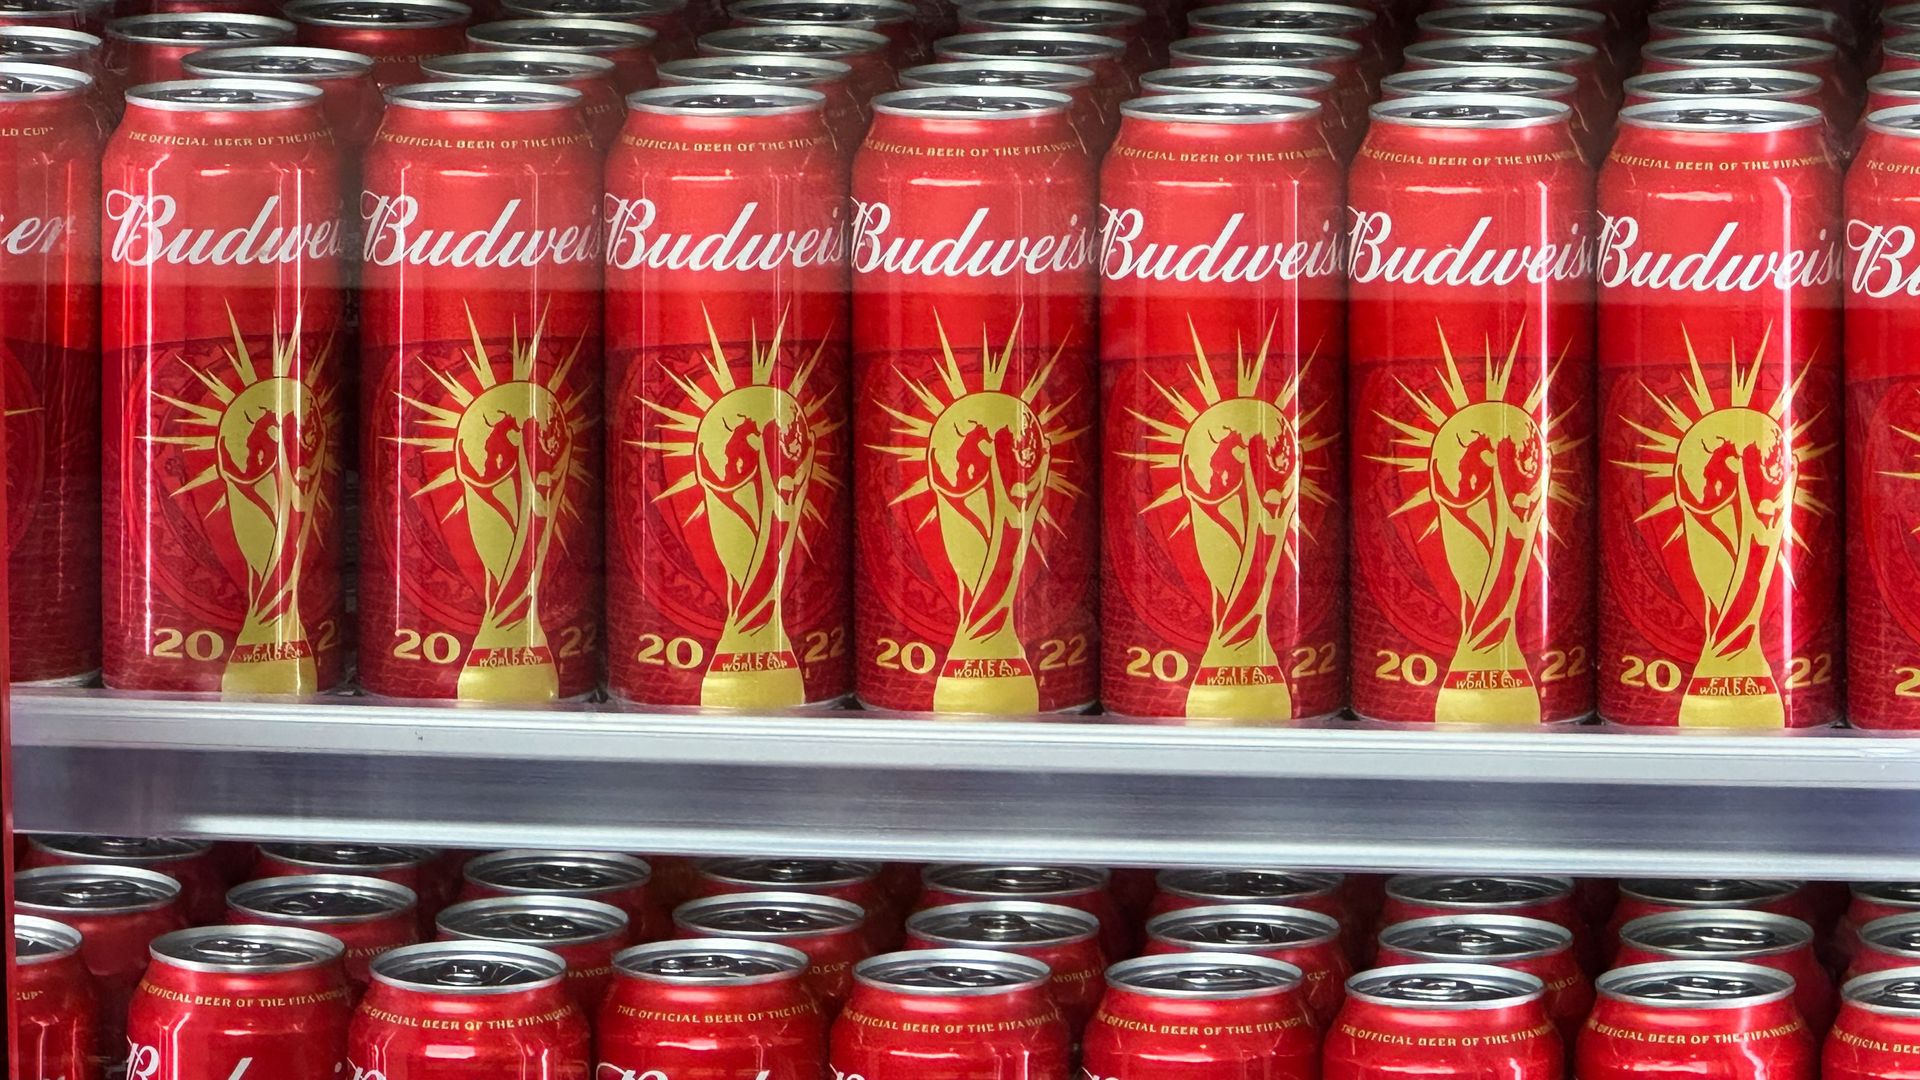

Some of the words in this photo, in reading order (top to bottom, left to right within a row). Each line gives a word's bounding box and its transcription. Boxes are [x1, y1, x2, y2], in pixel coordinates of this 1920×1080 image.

[214, 138, 252, 146] BEER
[258, 137, 274, 146] OF
[277, 135, 302, 145] THE
[456, 140, 495, 149] BEER
[500, 140, 519, 149] OF
[522, 139, 549, 148] THE
[694, 143, 732, 152] BEER
[737, 143, 756, 152] OF
[759, 141, 785, 151] THE
[927, 147, 965, 157] BEER
[970, 148, 989, 157] OF
[993, 147, 1021, 156] THE
[1180, 153, 1219, 163] BEER
[1224, 154, 1243, 162] OF
[1247, 153, 1275, 162] THE
[1428, 156, 1467, 166] BEER
[1472, 157, 1491, 166] OF
[1495, 156, 1523, 165] THE
[1675, 162, 1713, 171] BEER
[1719, 162, 1738, 171] OF
[1742, 161, 1770, 170] THE
[153, 628, 224, 661] 20
[253, 641, 297, 653] FIFA
[393, 628, 461, 664] 20
[489, 649, 534, 659] FIFA
[637, 633, 703, 669] 20
[876, 637, 936, 674] 20
[1039, 634, 1088, 671] 22
[732, 652, 780, 663] FIFA
[1126, 646, 1189, 682] 20
[1291, 642, 1337, 679] 22
[964, 660, 1012, 670] FIFA
[1375, 650, 1438, 686] 20
[1540, 646, 1586, 682] 22
[1216, 667, 1262, 678] FIFA
[1466, 671, 1513, 682] FIFA
[1620, 655, 1682, 692] 20
[1784, 653, 1832, 690] 22
[1710, 677, 1756, 688] FIFA
[195, 997, 230, 1007] BEER
[236, 999, 253, 1007] OF
[259, 998, 285, 1007] THE
[705, 1015, 744, 1023] BEER
[748, 1013, 765, 1022] OF
[767, 1010, 791, 1020] THE
[423, 1020, 460, 1030] BEER
[464, 1021, 483, 1031] OF
[486, 1020, 515, 1030] THE
[903, 1023, 940, 1033] BEER
[945, 1025, 963, 1034] OF
[968, 1024, 995, 1033] THE
[1161, 1026, 1199, 1035] BEER
[1204, 1027, 1221, 1036] OF
[1226, 1026, 1252, 1034] THE
[1418, 1038, 1456, 1047] BEER
[1462, 1038, 1480, 1047] OF
[1483, 1035, 1508, 1045] THE
[1648, 1034, 1686, 1044] BEER
[1691, 1035, 1710, 1045] OF
[1714, 1034, 1740, 1044] THE
